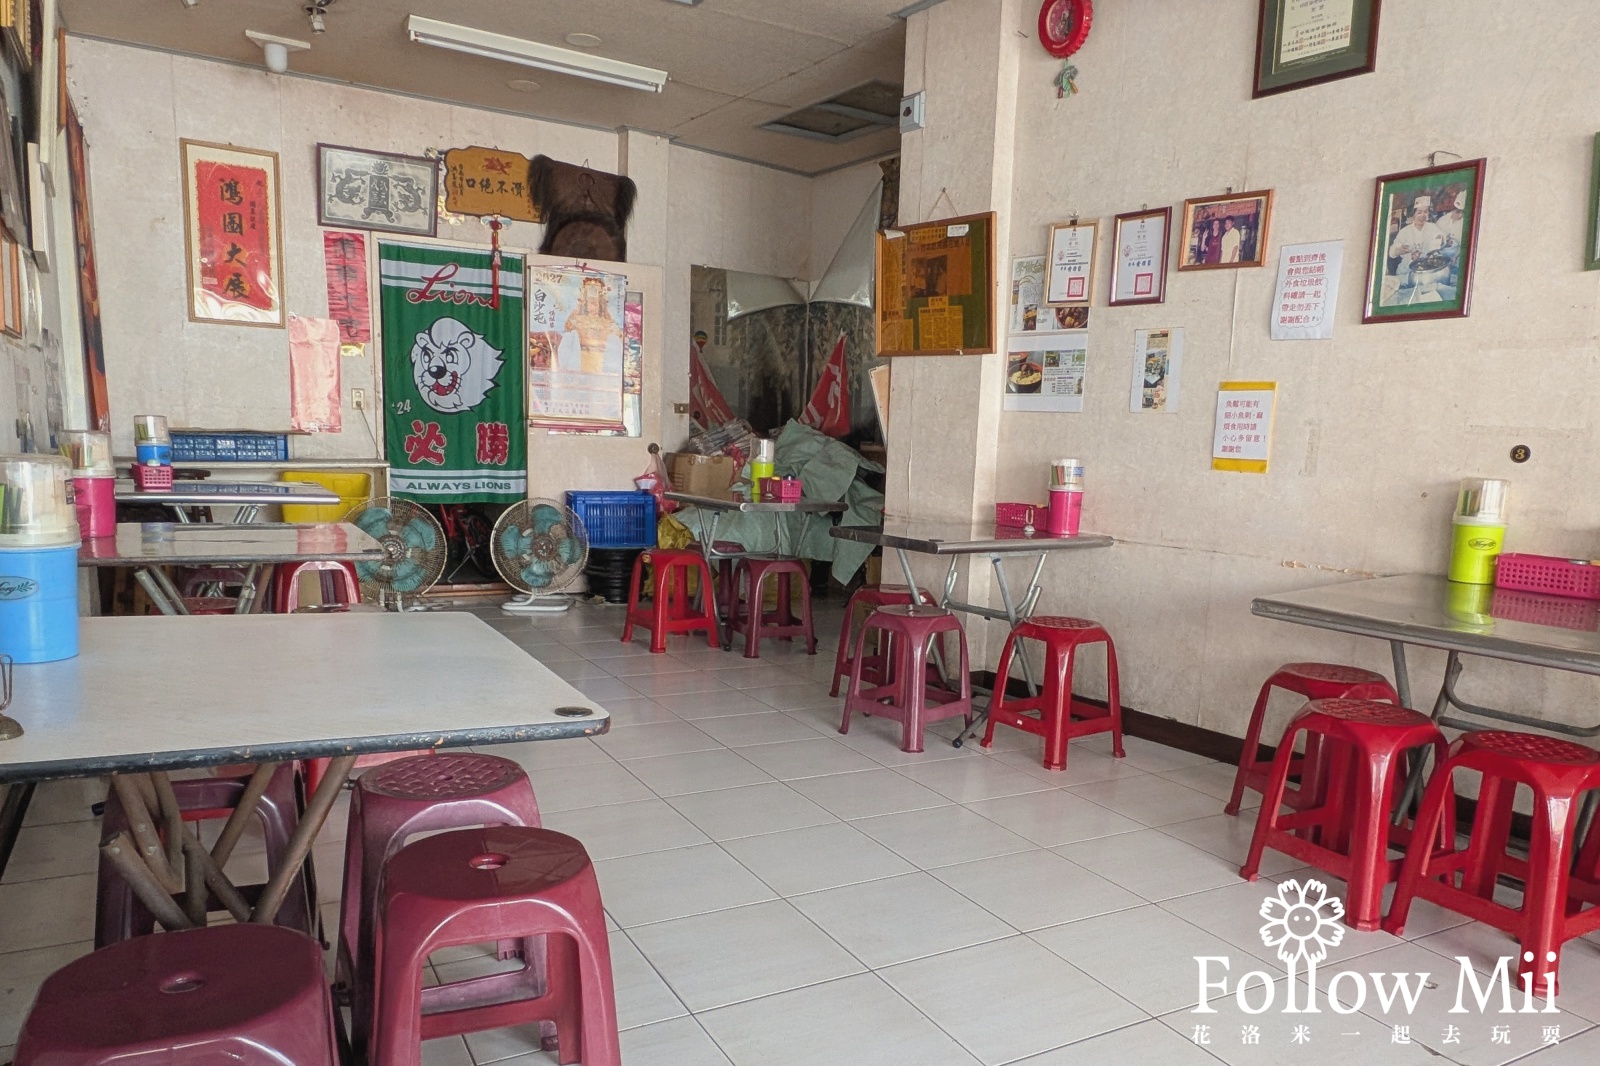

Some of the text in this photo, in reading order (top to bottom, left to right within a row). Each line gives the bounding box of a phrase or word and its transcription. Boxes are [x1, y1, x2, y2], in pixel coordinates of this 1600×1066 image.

[219, 178, 249, 299] 鴻圖大展
[1288, 253, 1327, 264] 餐點到齊後
[1284, 278, 1323, 288] 外食垃圾飲
[534, 288, 547, 324] 白沙屯
[1279, 315, 1310, 324] 謝謝配合
[1515, 448, 1526, 460] 3
[405, 482, 512, 491] ALWAYS LIONS
